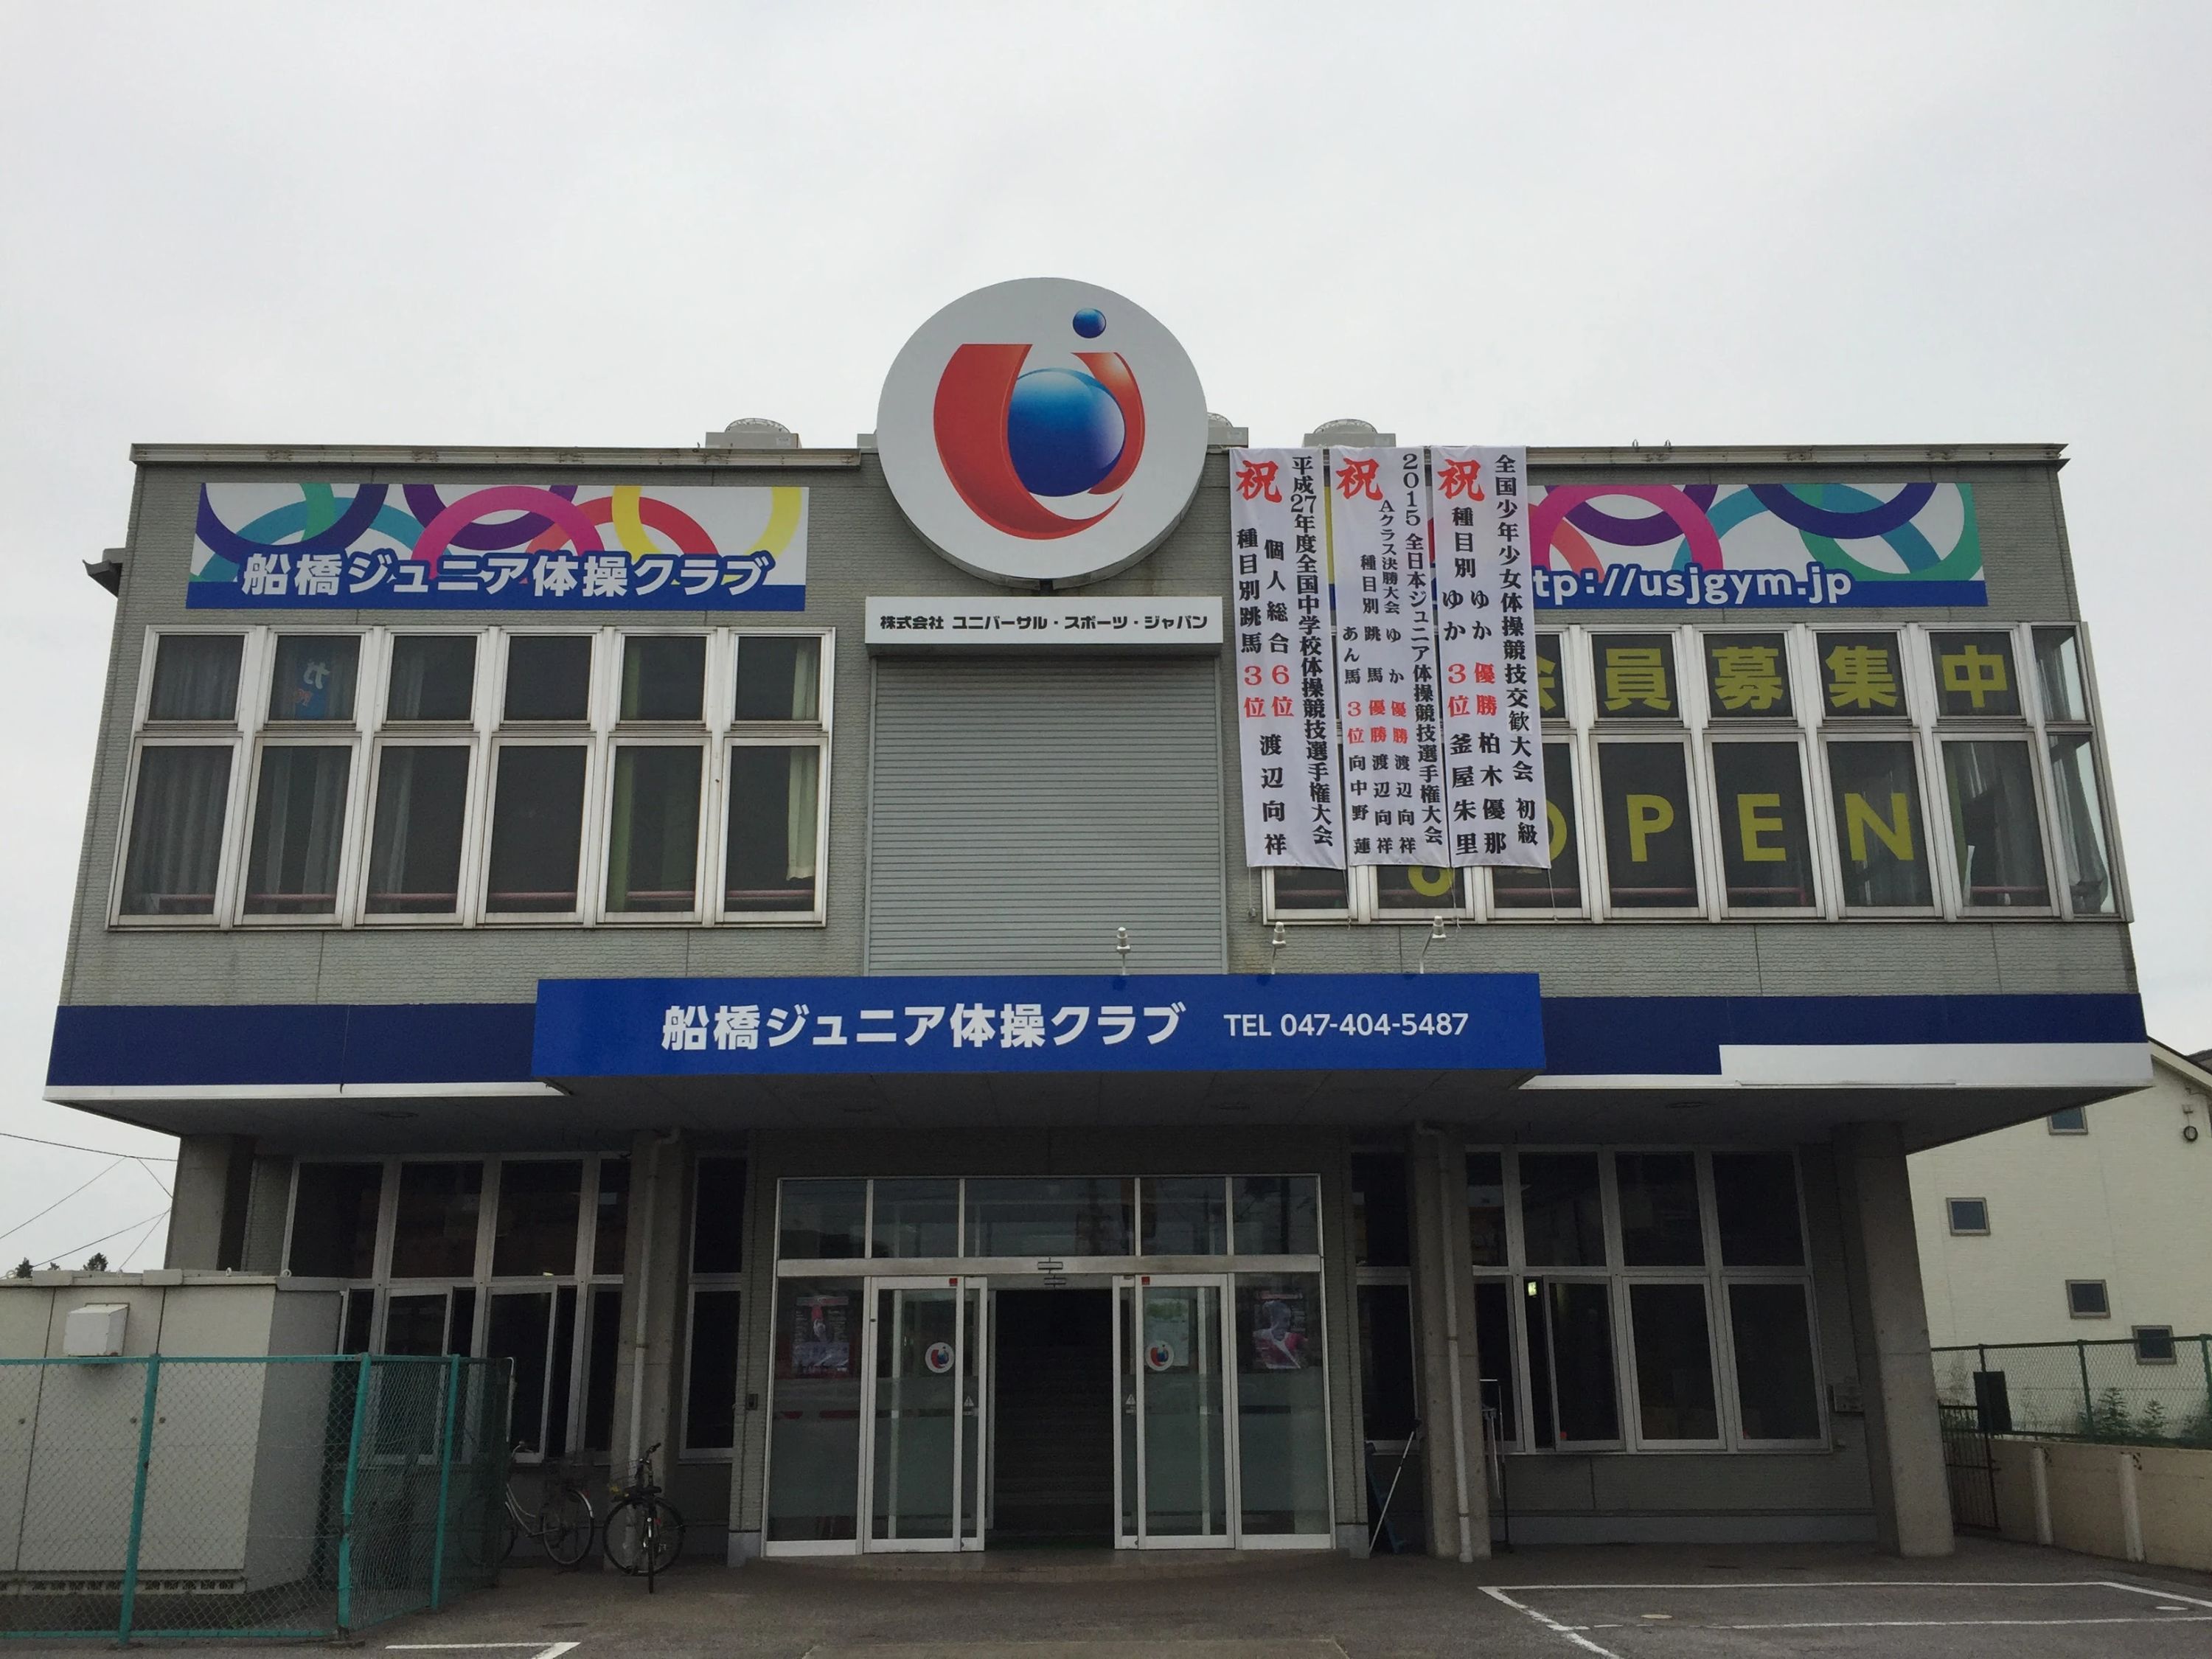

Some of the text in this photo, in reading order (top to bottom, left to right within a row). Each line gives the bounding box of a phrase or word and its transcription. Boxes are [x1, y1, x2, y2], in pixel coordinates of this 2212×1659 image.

[1236, 460, 1282, 504] 祝
[1336, 458, 1384, 501] 祝
[1439, 459, 1486, 502] 祝
[1451, 507, 1476, 579] 種目別
[241, 552, 770, 597] 船橋ジュニア体操クラブ
[880, 616, 944, 630] 株式会社
[661, 1001, 1469, 1051] 船橋ジュニア体操クラブ TEL 047-404-5487
